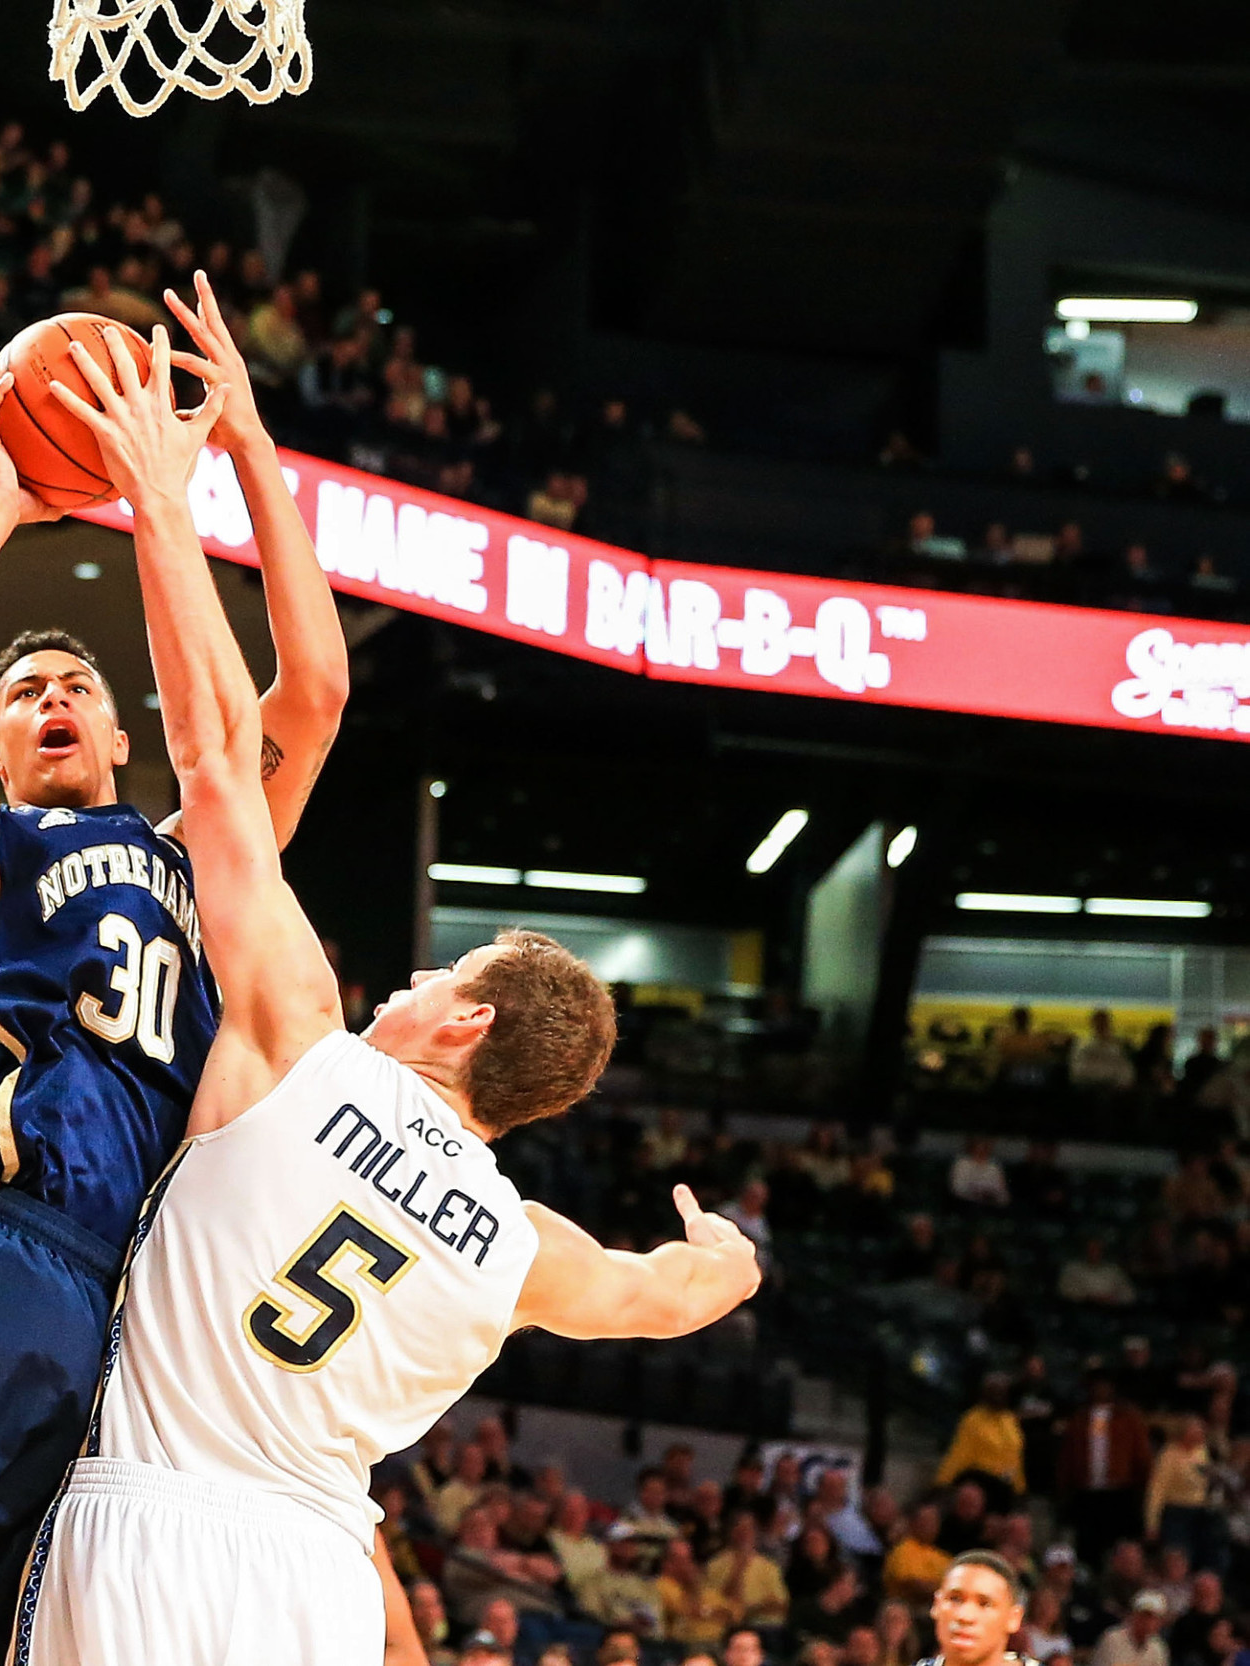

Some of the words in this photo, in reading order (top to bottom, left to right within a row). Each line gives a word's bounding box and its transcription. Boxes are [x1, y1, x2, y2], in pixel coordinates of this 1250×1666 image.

[315, 480, 489, 614] NAME
[506, 535, 569, 636] IN
[36, 844, 150, 922] NOTRE
[75, 912, 182, 1065] 30
[314, 1103, 500, 1268] MILLER
[406, 1118, 463, 1157] ACC
[242, 1200, 421, 1374] 5
